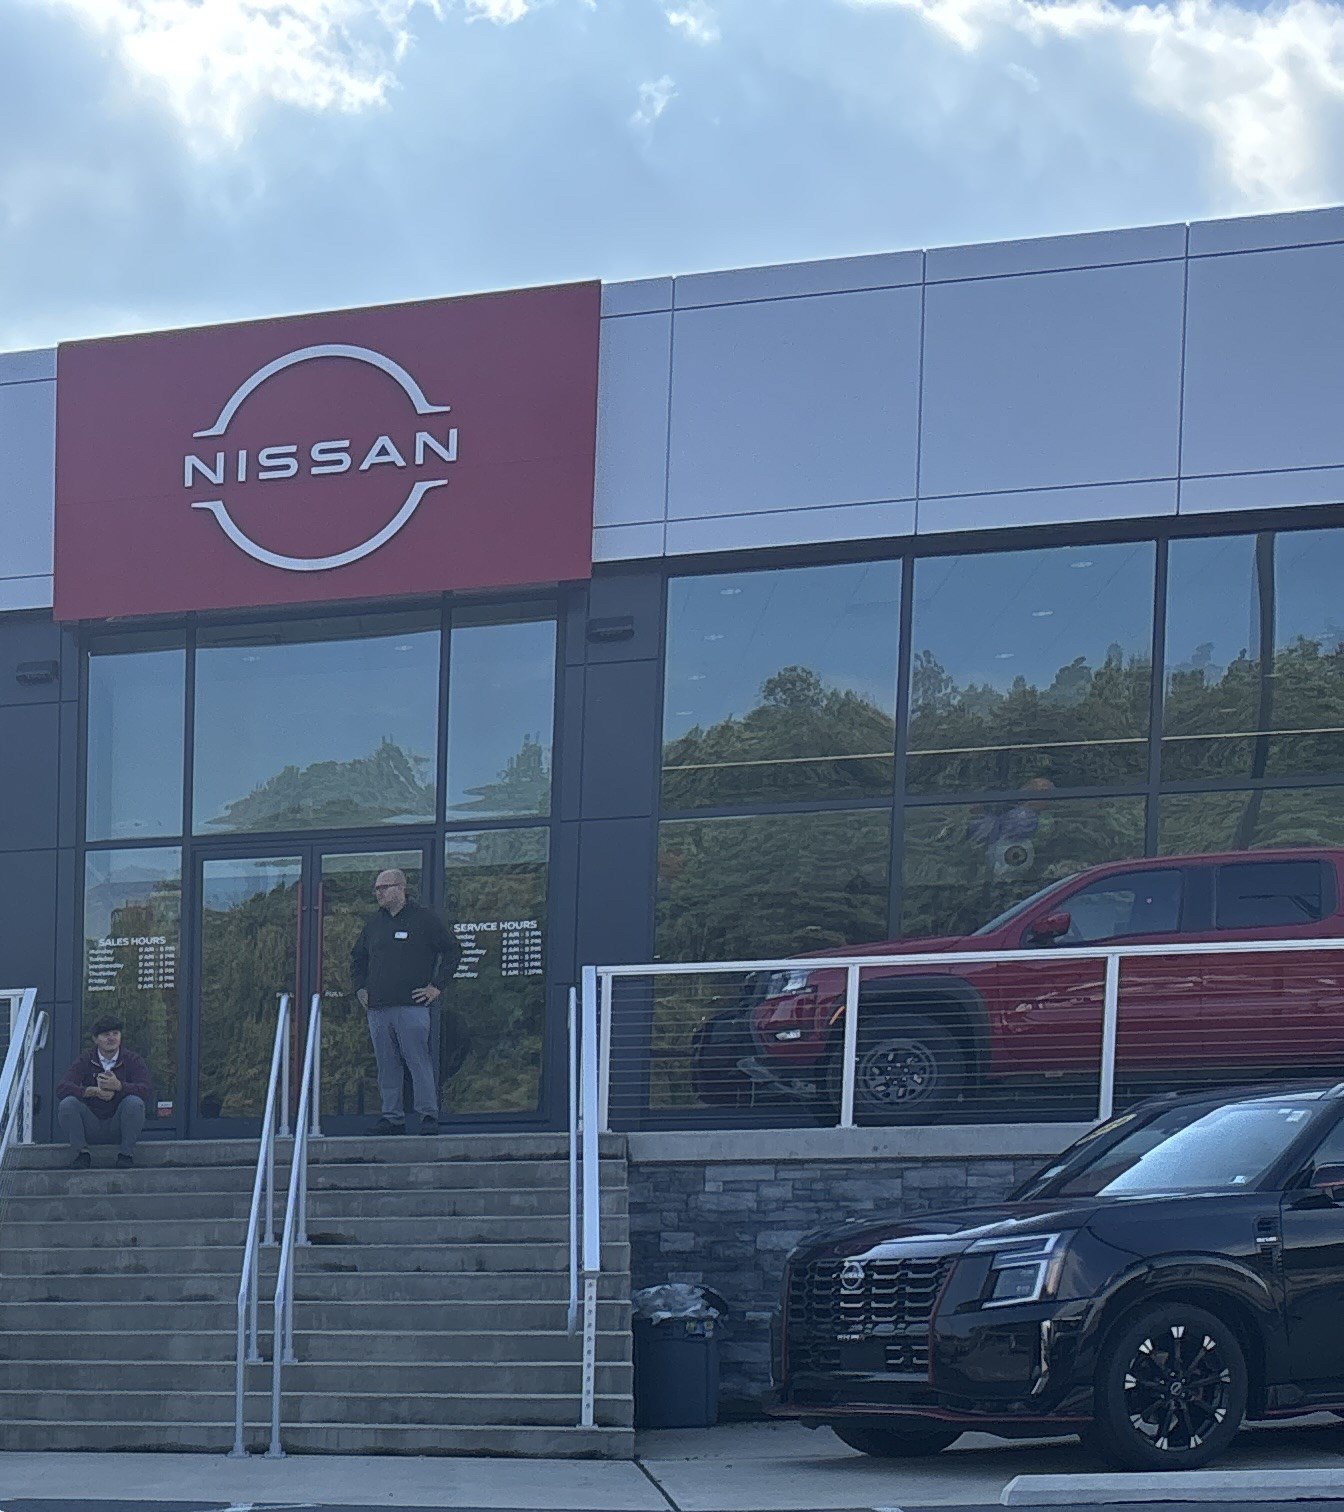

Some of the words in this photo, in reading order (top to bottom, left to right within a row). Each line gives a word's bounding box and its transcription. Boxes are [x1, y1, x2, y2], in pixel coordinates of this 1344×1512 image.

[184, 428, 458, 488] NISSAN
[453, 923, 498, 932] SERVICE
[500, 920, 537, 930] HOURS
[99, 938, 129, 946] SALES
[131, 936, 166, 945] HOURS
